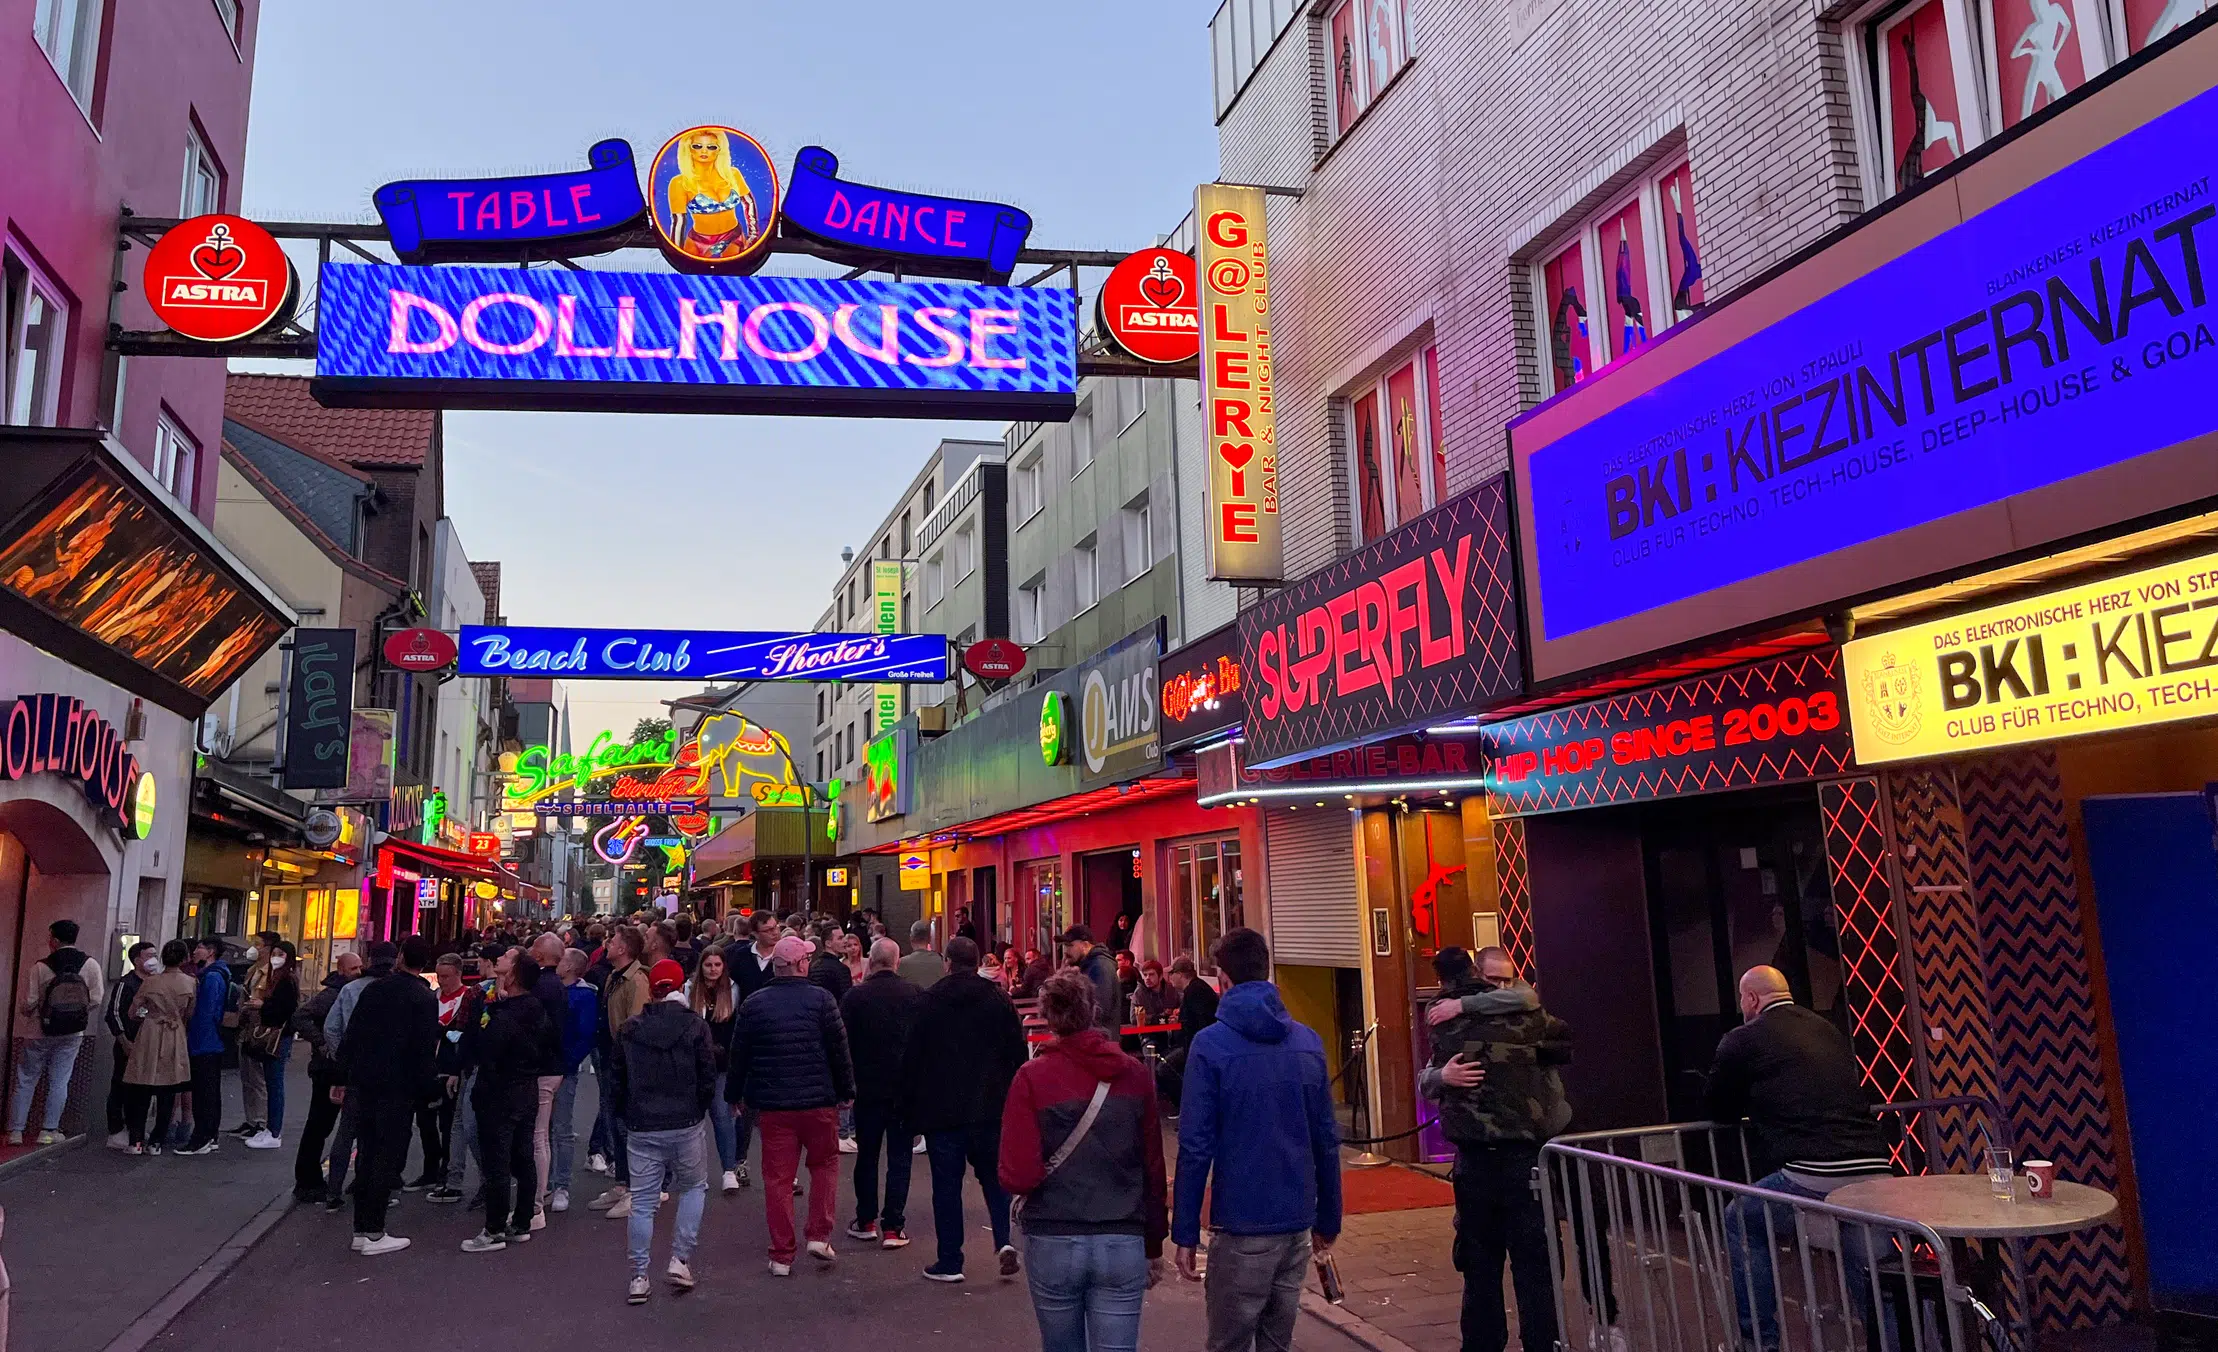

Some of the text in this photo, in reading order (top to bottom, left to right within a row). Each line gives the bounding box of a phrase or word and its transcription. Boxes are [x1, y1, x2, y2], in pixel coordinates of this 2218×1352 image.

[448, 184, 601, 231] TABLE
[824, 191, 967, 248] DANCE
[1987, 176, 2210, 296] BLANKENESE KIEZINTERNAT
[171, 283, 258, 303] ASTRA
[387, 287, 1027, 369] DOLLHOUSE
[1127, 312, 1198, 328] ASTRA
[1253, 240, 1279, 514] BAR & NIGHT CLUB
[1605, 447, 1693, 541] BKI
[1725, 202, 2217, 493] KIEZINTERNAT
[1603, 339, 1864, 477] DAS ELEKTRONISCHE HERZ VON ST.PAULI
[1612, 539, 1651, 568] CLUB
[1688, 496, 1766, 538] TECHNO,
[1769, 440, 1914, 510] TECH-HOUSE,
[1921, 365, 2101, 454] DEEP-HOUSE
[2110, 355, 2133, 383] &
[2142, 322, 2217, 371] GOA
[878, 601, 896, 635] den
[1258, 533, 1472, 721] SUPERFLY
[1933, 630, 1961, 650] DAS
[1965, 602, 2084, 643] ELEKTRONISCHE
[2089, 590, 2133, 615] HERZ
[2137, 579, 2181, 603] VON
[403, 653, 435, 663] ASTRA
[471, 634, 691, 672] Beach Club
[761, 637, 885, 676] Shooter's
[888, 670, 935, 679] Große Freiheit
[981, 662, 1010, 671] ASTRA
[1217, 655, 1240, 696] Ba
[1937, 633, 2050, 712] BKI
[878, 694, 896, 733] otel
[1494, 690, 1841, 784] HIP HOP SINCE 2003
[1946, 714, 1996, 738] CLUB
[2002, 705, 2040, 730] FÜR
[2045, 691, 2142, 724] TECHNO,
[0, 693, 140, 828] OLLHOUSE
[507, 729, 678, 800] Safari
[1145, 741, 1158, 760] Club
[562, 803, 668, 815] SPIELHALLE
[475, 839, 490, 850] 23
